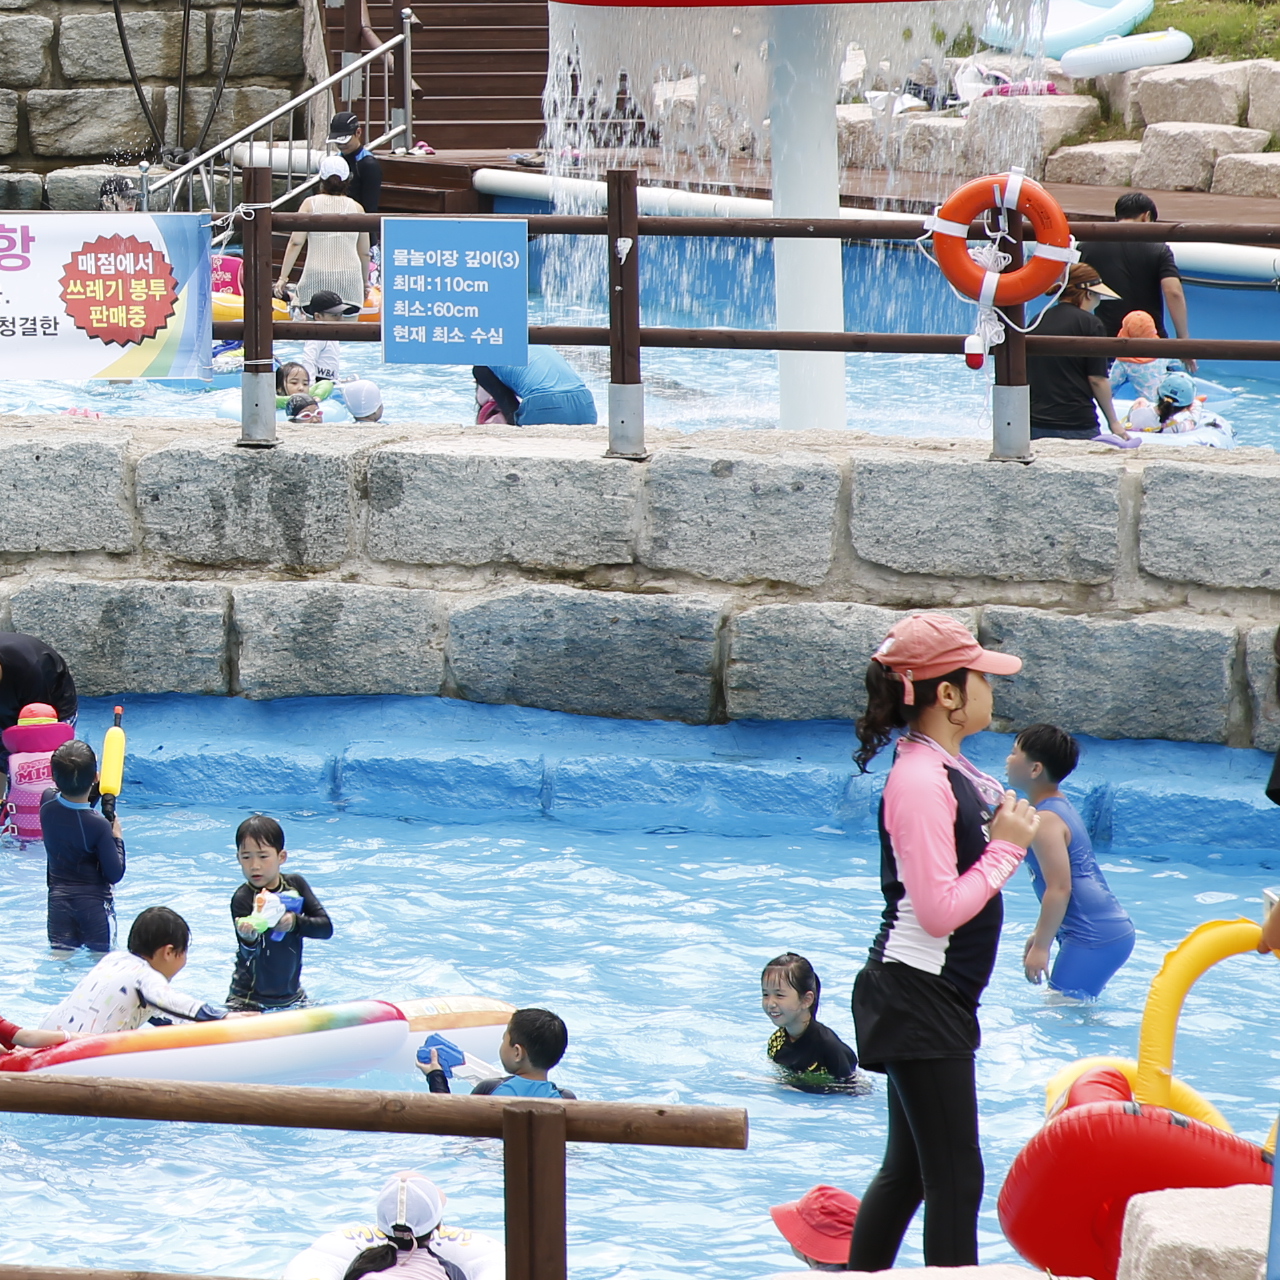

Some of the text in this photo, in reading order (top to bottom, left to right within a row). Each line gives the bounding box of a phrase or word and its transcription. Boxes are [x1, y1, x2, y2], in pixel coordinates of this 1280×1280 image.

[77, 252, 154, 276] 매점에서
[392, 249, 520, 269] 물놀이장 깊이(3)
[66, 278, 168, 302] 쓰레기 봉투
[392, 274, 489, 292] 최대:110cm
[88, 303, 147, 328] 판매중
[392, 300, 479, 318] 최소:60cm
[392, 325, 504, 345] 현재 최소 수심
